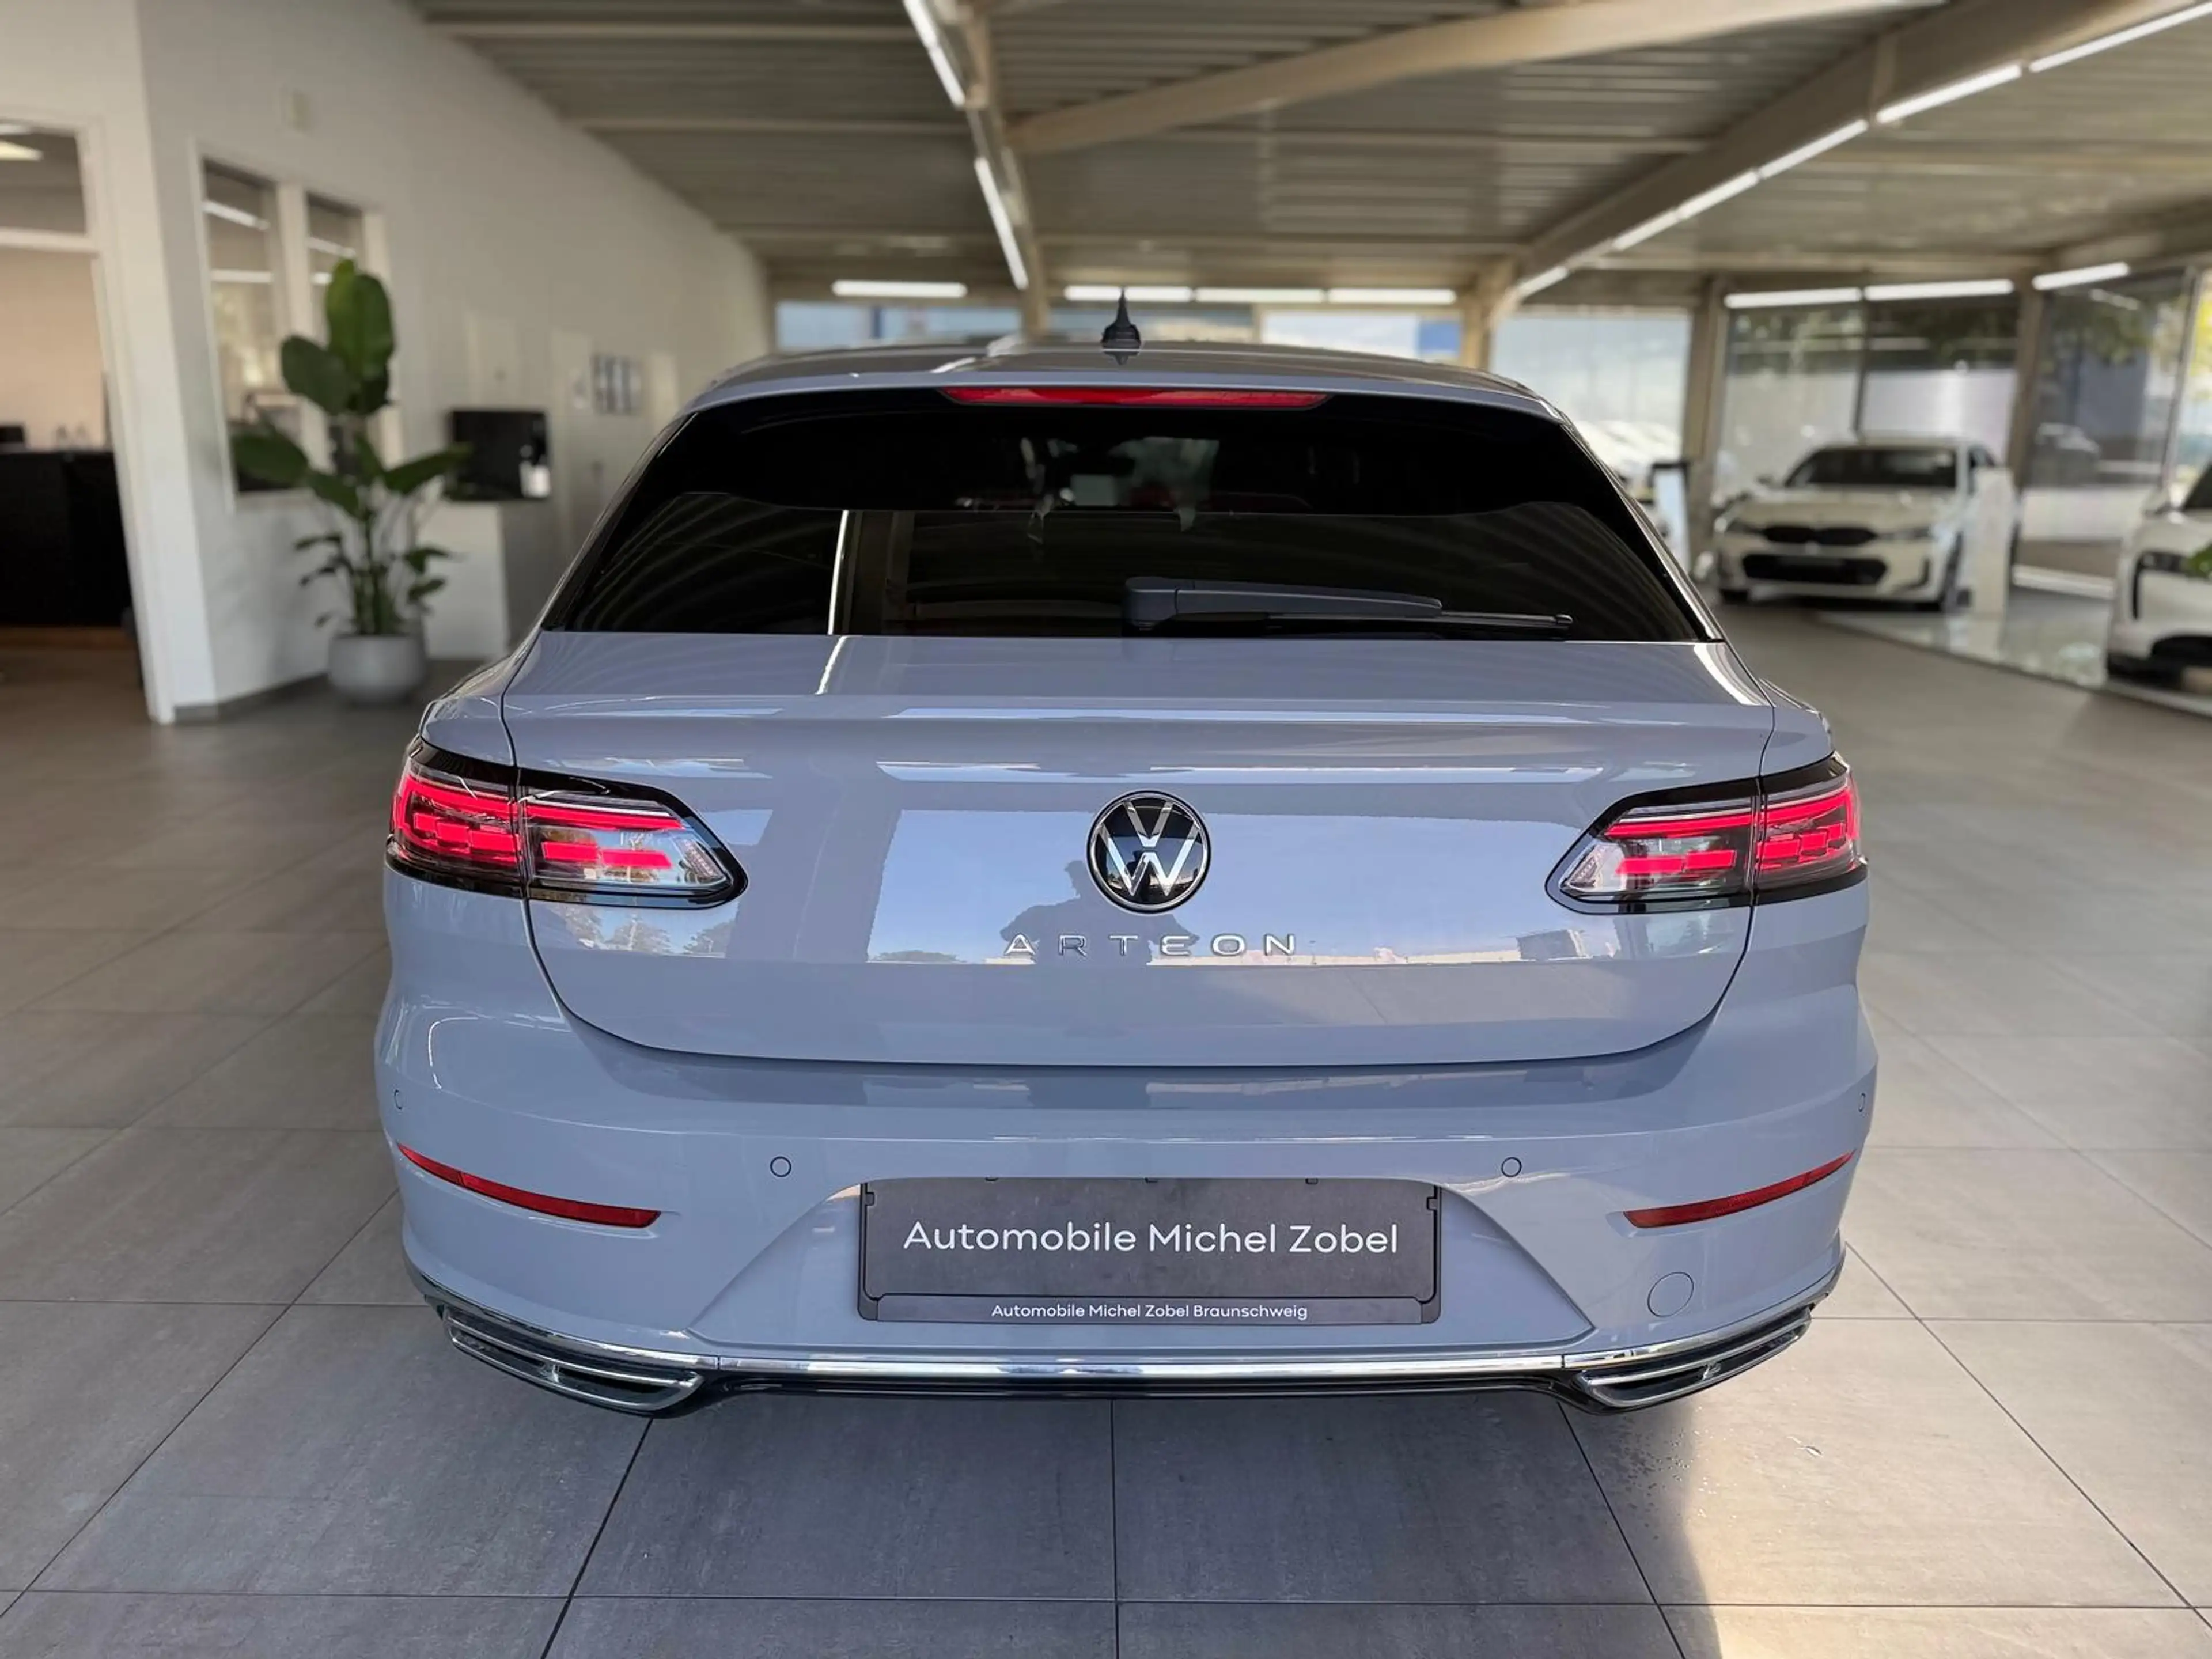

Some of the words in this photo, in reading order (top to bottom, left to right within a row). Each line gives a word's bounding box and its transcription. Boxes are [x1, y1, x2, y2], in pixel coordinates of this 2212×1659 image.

[1094, 797, 1205, 900] VW
[1005, 934, 1296, 956] ARTEON
[903, 1221, 1137, 1252] Automobile
[1149, 1222, 1276, 1253] Michel
[1288, 1223, 1397, 1254] Zobel
[991, 1303, 1085, 1317] Automobile
[1089, 1304, 1141, 1318] Michel
[1144, 1304, 1190, 1318] Zobel
[1193, 1304, 1308, 1321] Braunschweig
